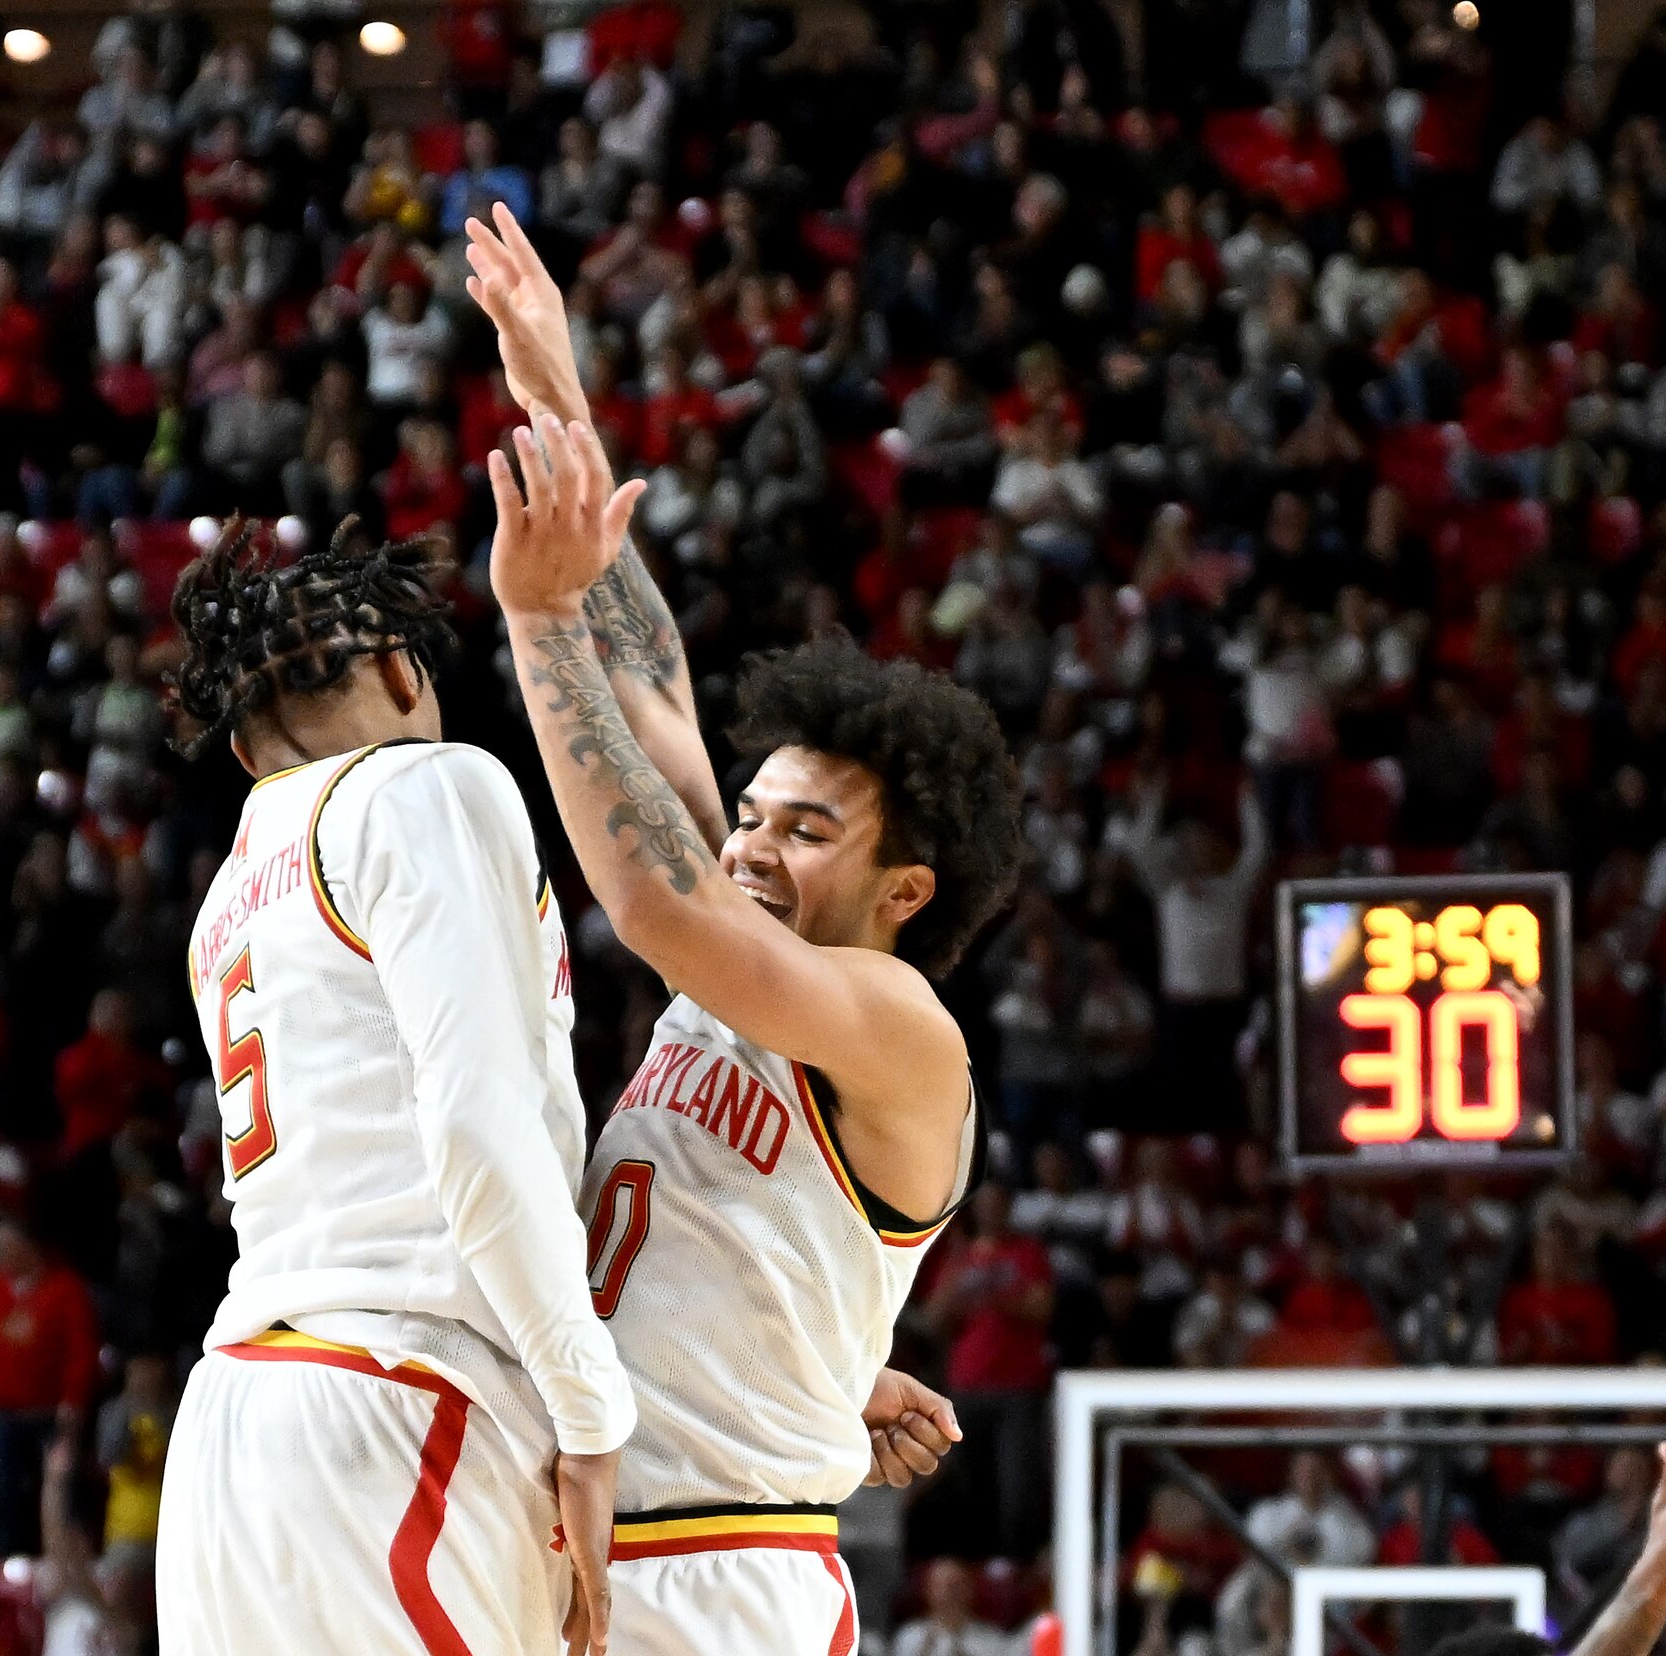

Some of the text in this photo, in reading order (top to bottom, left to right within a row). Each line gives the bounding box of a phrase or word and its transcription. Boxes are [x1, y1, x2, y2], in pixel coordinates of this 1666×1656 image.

[1363, 904, 1541, 996] 3:59
[218, 942, 278, 1183] 5
[610, 1042, 791, 1176] ARYLAND
[1339, 990, 1521, 1144] 30
[587, 1158, 656, 1320] 0
